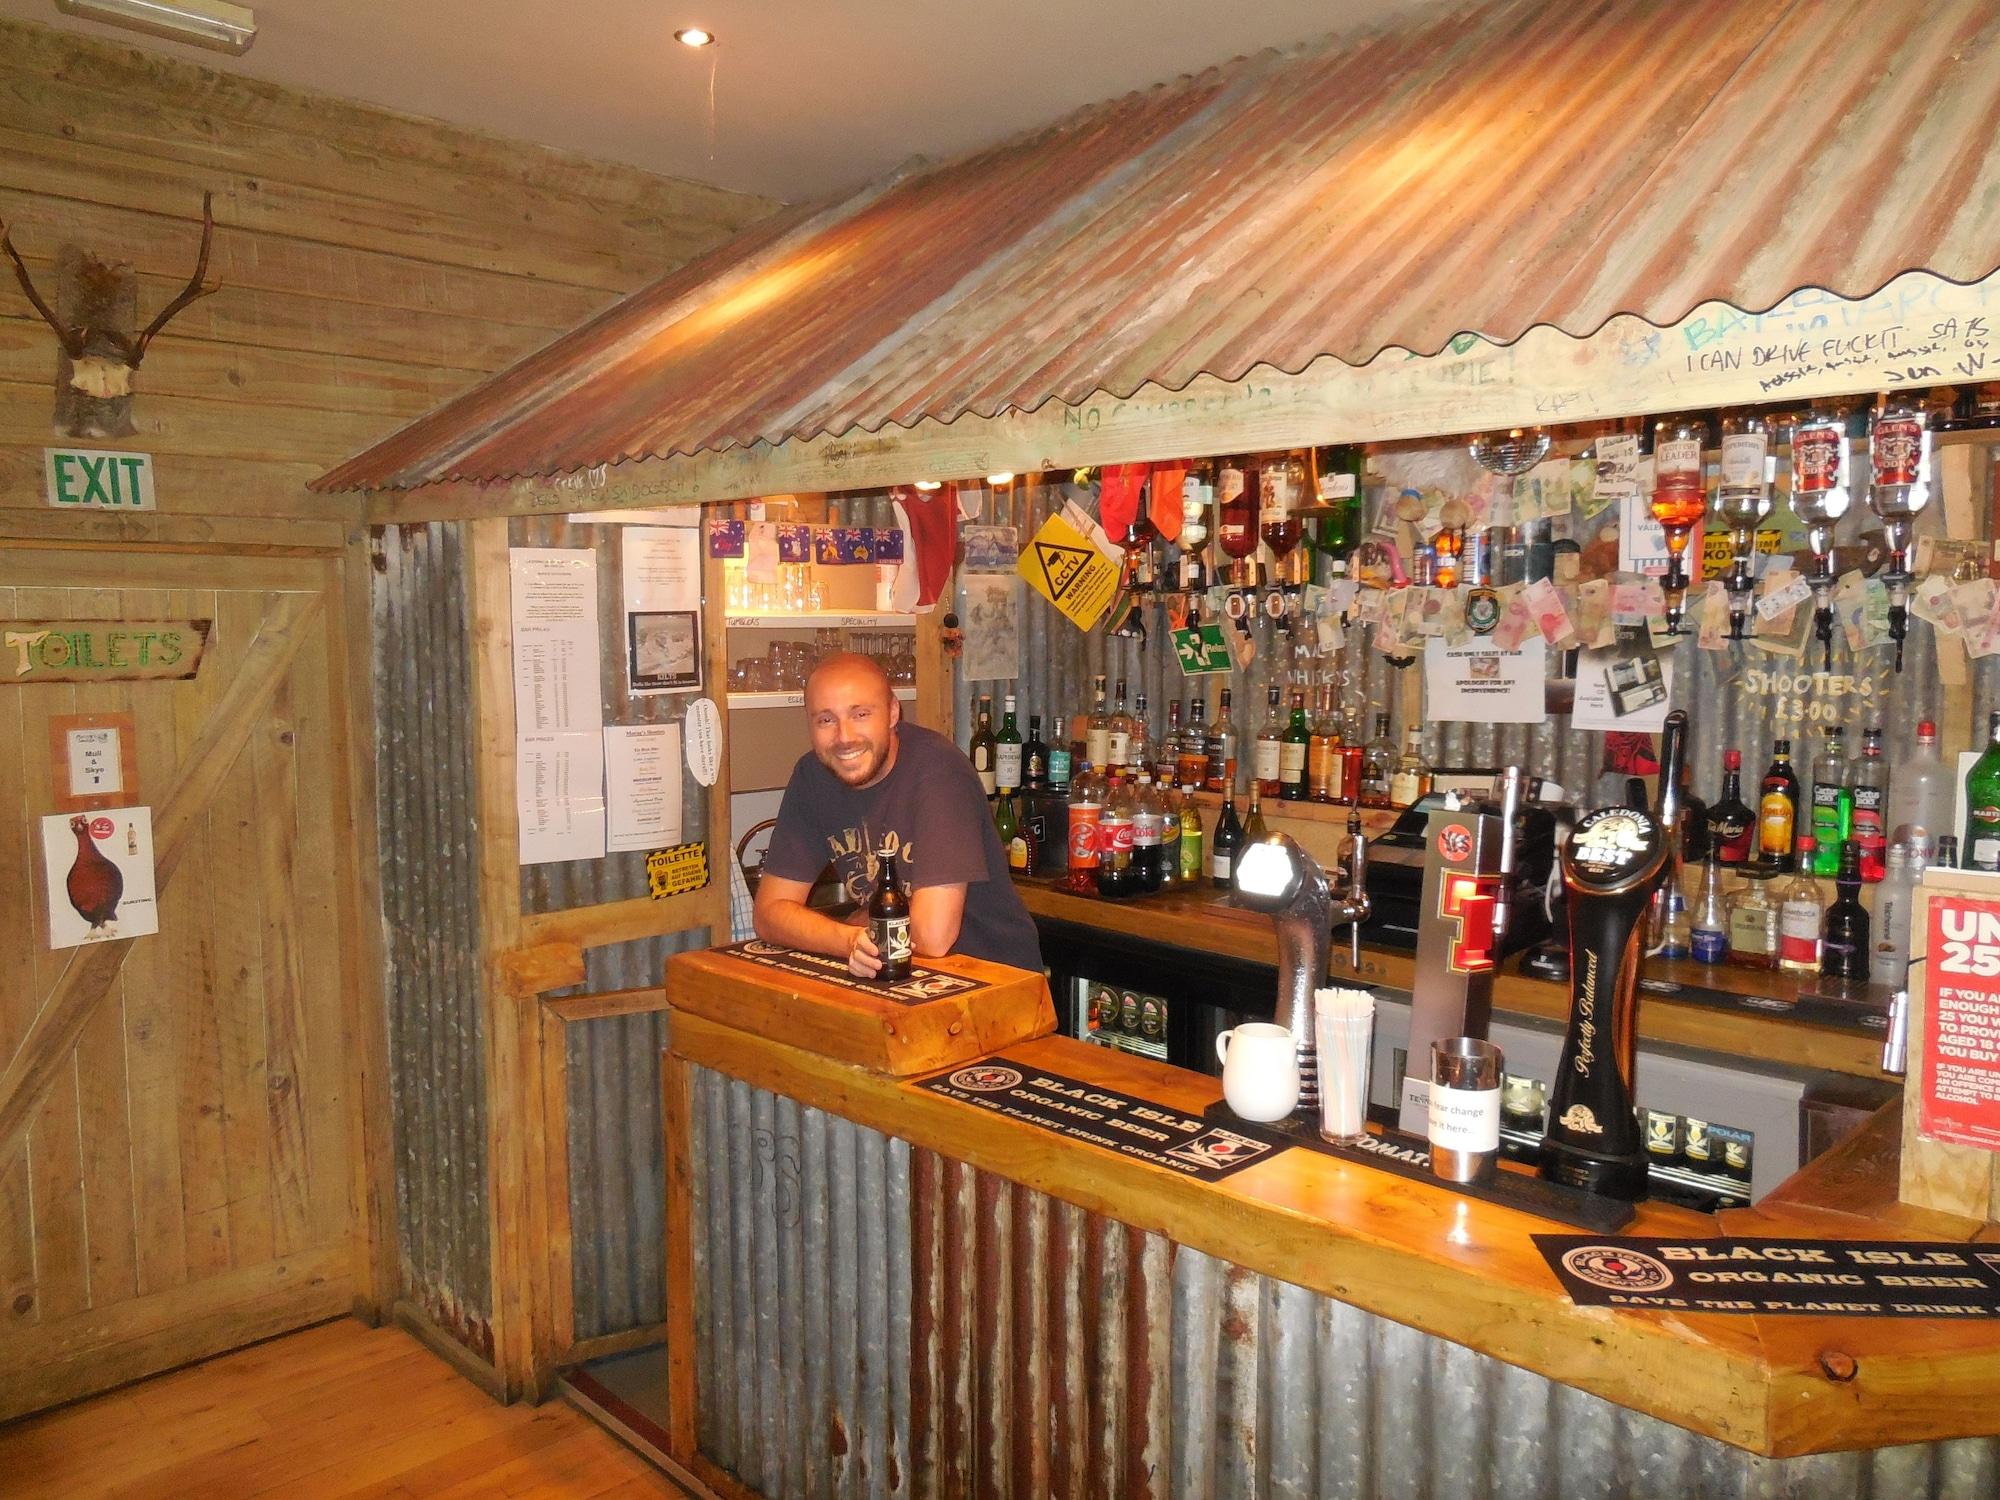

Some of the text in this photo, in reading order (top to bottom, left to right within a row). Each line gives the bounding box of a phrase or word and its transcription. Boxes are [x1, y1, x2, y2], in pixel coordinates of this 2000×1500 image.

[1700, 347, 1742, 372] CAN
[1752, 338, 1811, 367] DRIVE
[1063, 406, 1100, 432] NO
[1660, 450, 1697, 461] LEADER
[54, 454, 144, 505] EXIT
[1054, 556, 1080, 587] CCTV
[1065, 564, 1096, 601] WARNING
[5, 630, 182, 677] TOILETS
[1744, 669, 1873, 697] SHOOTERS
[1583, 809, 1652, 834] CALEDONIA
[1716, 821, 1744, 836] Maria
[651, 849, 699, 867] TOILETTE
[1575, 847, 1633, 865] BEST
[1939, 942, 2000, 977] 25
[1939, 987, 1953, 998] IF
[1956, 988, 1987, 1002] YOU
[1574, 948, 1598, 1078] Perfectly Balanced
[1939, 1000, 1999, 1015] ENOUGH
[1938, 1011, 1957, 1022] 25
[1958, 1013, 1988, 1025] YOU
[1938, 1022, 1958, 1034] TO
[1937, 1034, 1993, 1050] AGED 18
[1937, 1045, 1998, 1063] YOU BUY
[1936, 1070, 1977, 1082] YOU ARE
[1946, 1064, 1966, 1073] YOU
[1967, 1067, 1987, 1076] ARE
[1936, 1084, 1992, 1100] ATTEMPT TO
[1951, 1080, 1994, 1092] OFFENCE
[1029, 1077, 1204, 1133] BLACK ISLE
[1450, 1103, 1484, 1118] change
[1009, 1089, 1171, 1142] ORGANIC BEER
[930, 1084, 1200, 1172] SAVE THE PLANET DRINK ORGANIC
[1439, 1121, 1445, 1129] it
[1707, 1126, 1751, 1142] POLAR
[1215, 1130, 1247, 1143] BLACK
[1657, 1246, 1968, 1267] BLACK ISLE
[1688, 1271, 1989, 1289] ORGANIC BEER
[1609, 1294, 1988, 1314] SAVE THE PLANET DRINK
